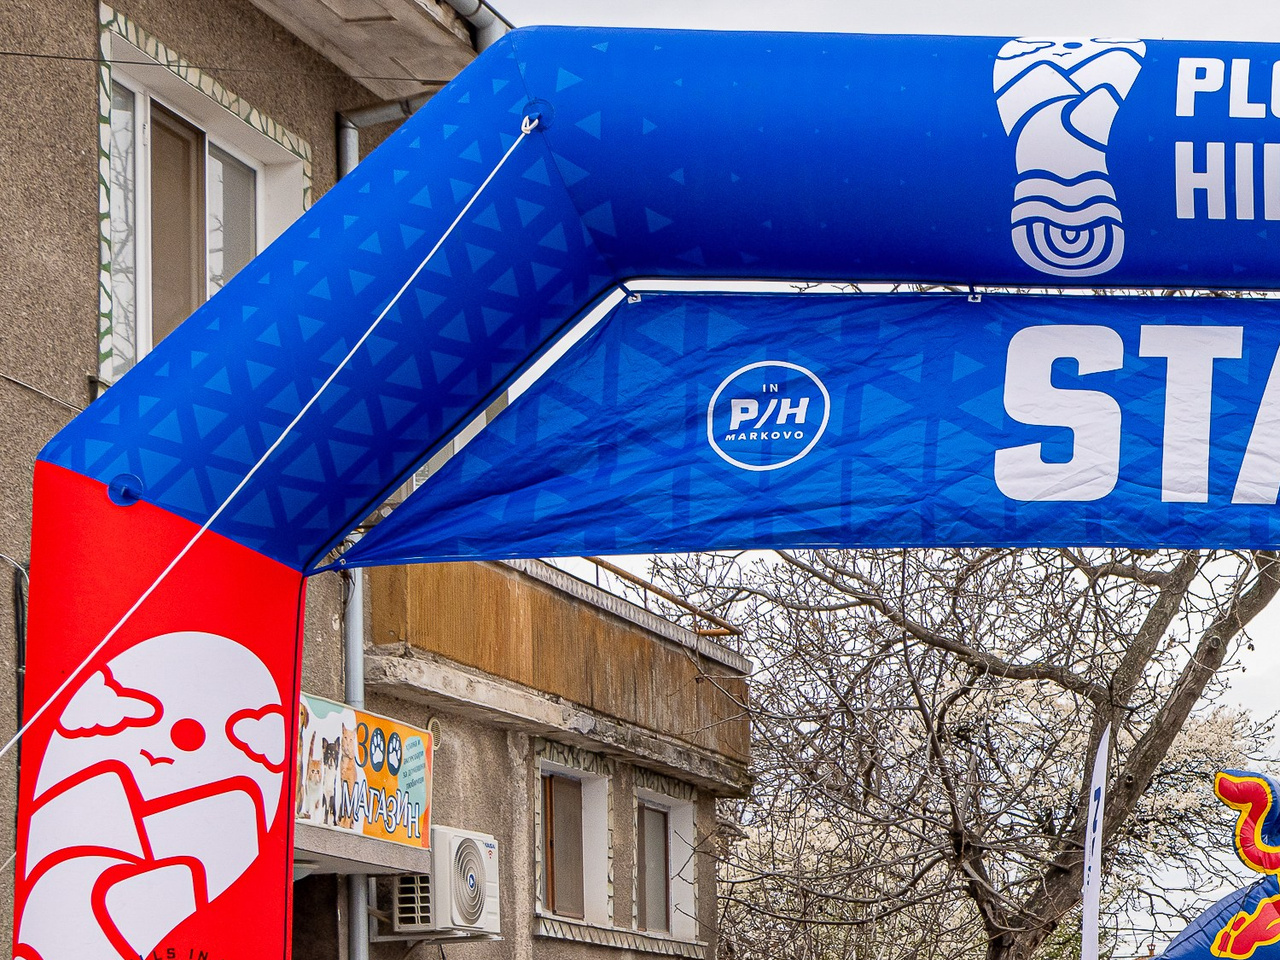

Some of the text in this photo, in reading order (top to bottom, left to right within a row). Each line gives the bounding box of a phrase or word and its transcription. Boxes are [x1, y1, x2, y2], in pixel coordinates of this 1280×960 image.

[762, 383, 779, 393] IN
[729, 397, 810, 431] P/H
[725, 430, 804, 441] MARKOVO
[341, 780, 421, 838] МАГАЗИН
